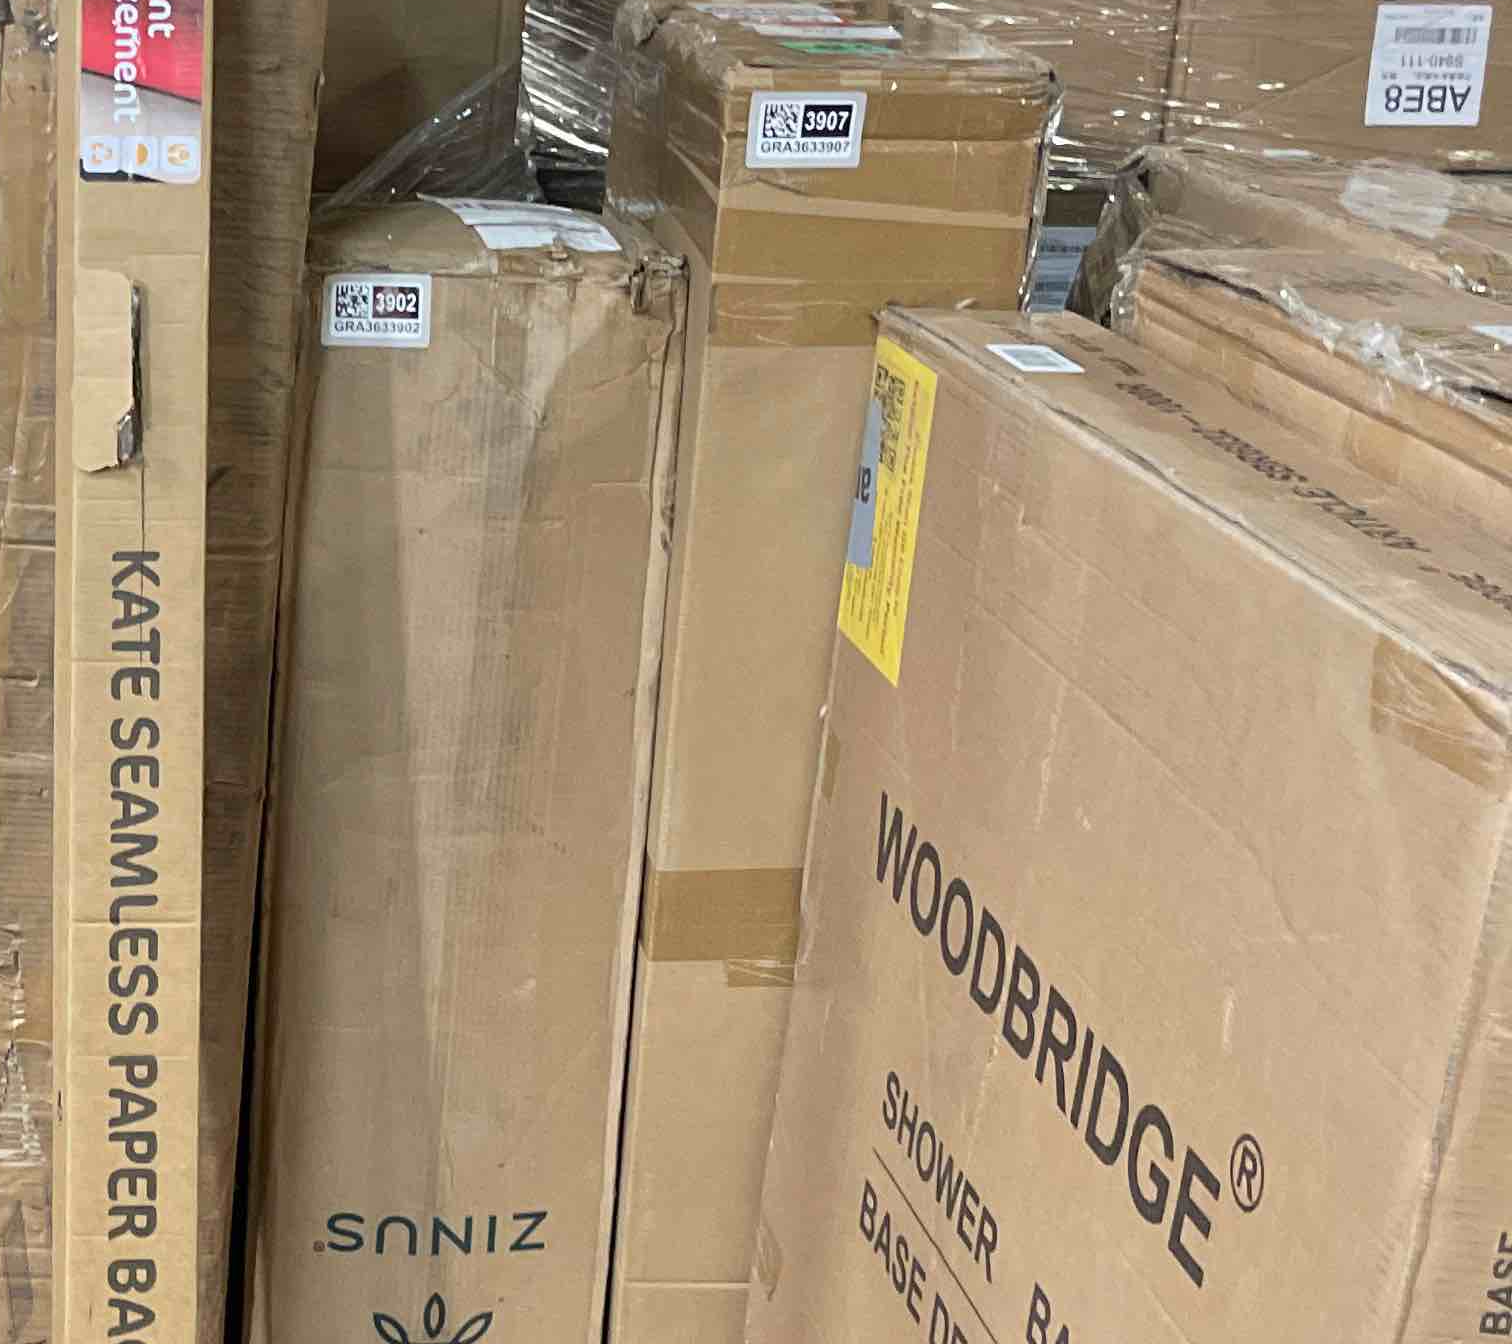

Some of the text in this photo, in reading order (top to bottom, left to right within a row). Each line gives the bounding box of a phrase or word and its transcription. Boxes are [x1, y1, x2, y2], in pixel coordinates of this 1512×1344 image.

[804, 110, 850, 132] 3907
[1383, 83, 1472, 113] ABE8
[760, 141, 851, 154] GRA3633907
[334, 320, 421, 335] GRA3633902
[375, 292, 418, 313] 3902
[110, 551, 161, 702] KATE
[107, 717, 161, 1038] SEAMLESS
[105, 1055, 159, 1241] PAPER
[882, 1070, 998, 1284] SHOWER
[859, 1178, 926, 1325] BASE
